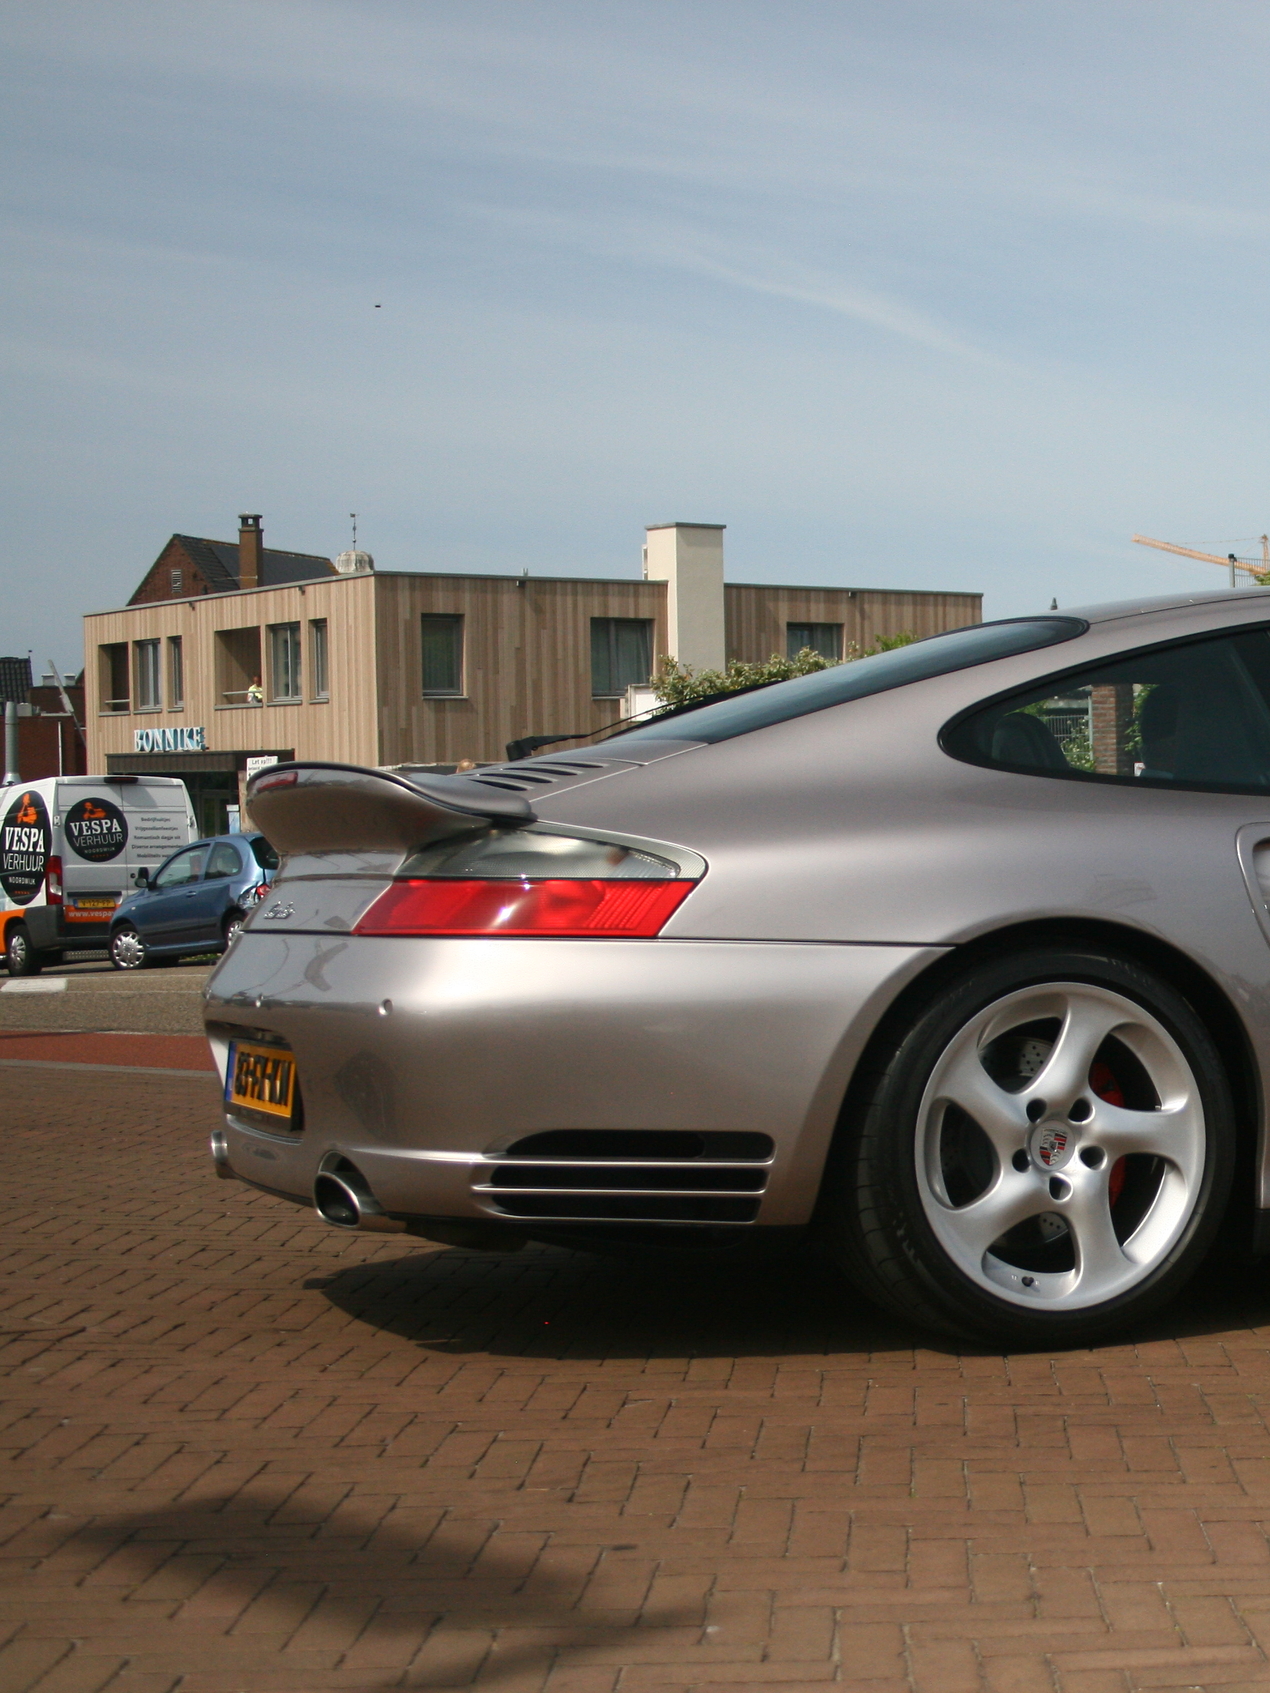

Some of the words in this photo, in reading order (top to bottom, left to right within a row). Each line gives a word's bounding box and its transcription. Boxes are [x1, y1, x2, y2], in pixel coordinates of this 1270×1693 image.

[70, 818, 122, 836] VESPA
[5, 827, 45, 853] VESPA
[73, 833, 124, 847] VERHUUR
[3, 853, 44, 873] VERHUUR
[8, 876, 36, 885] NOORDWIJK
